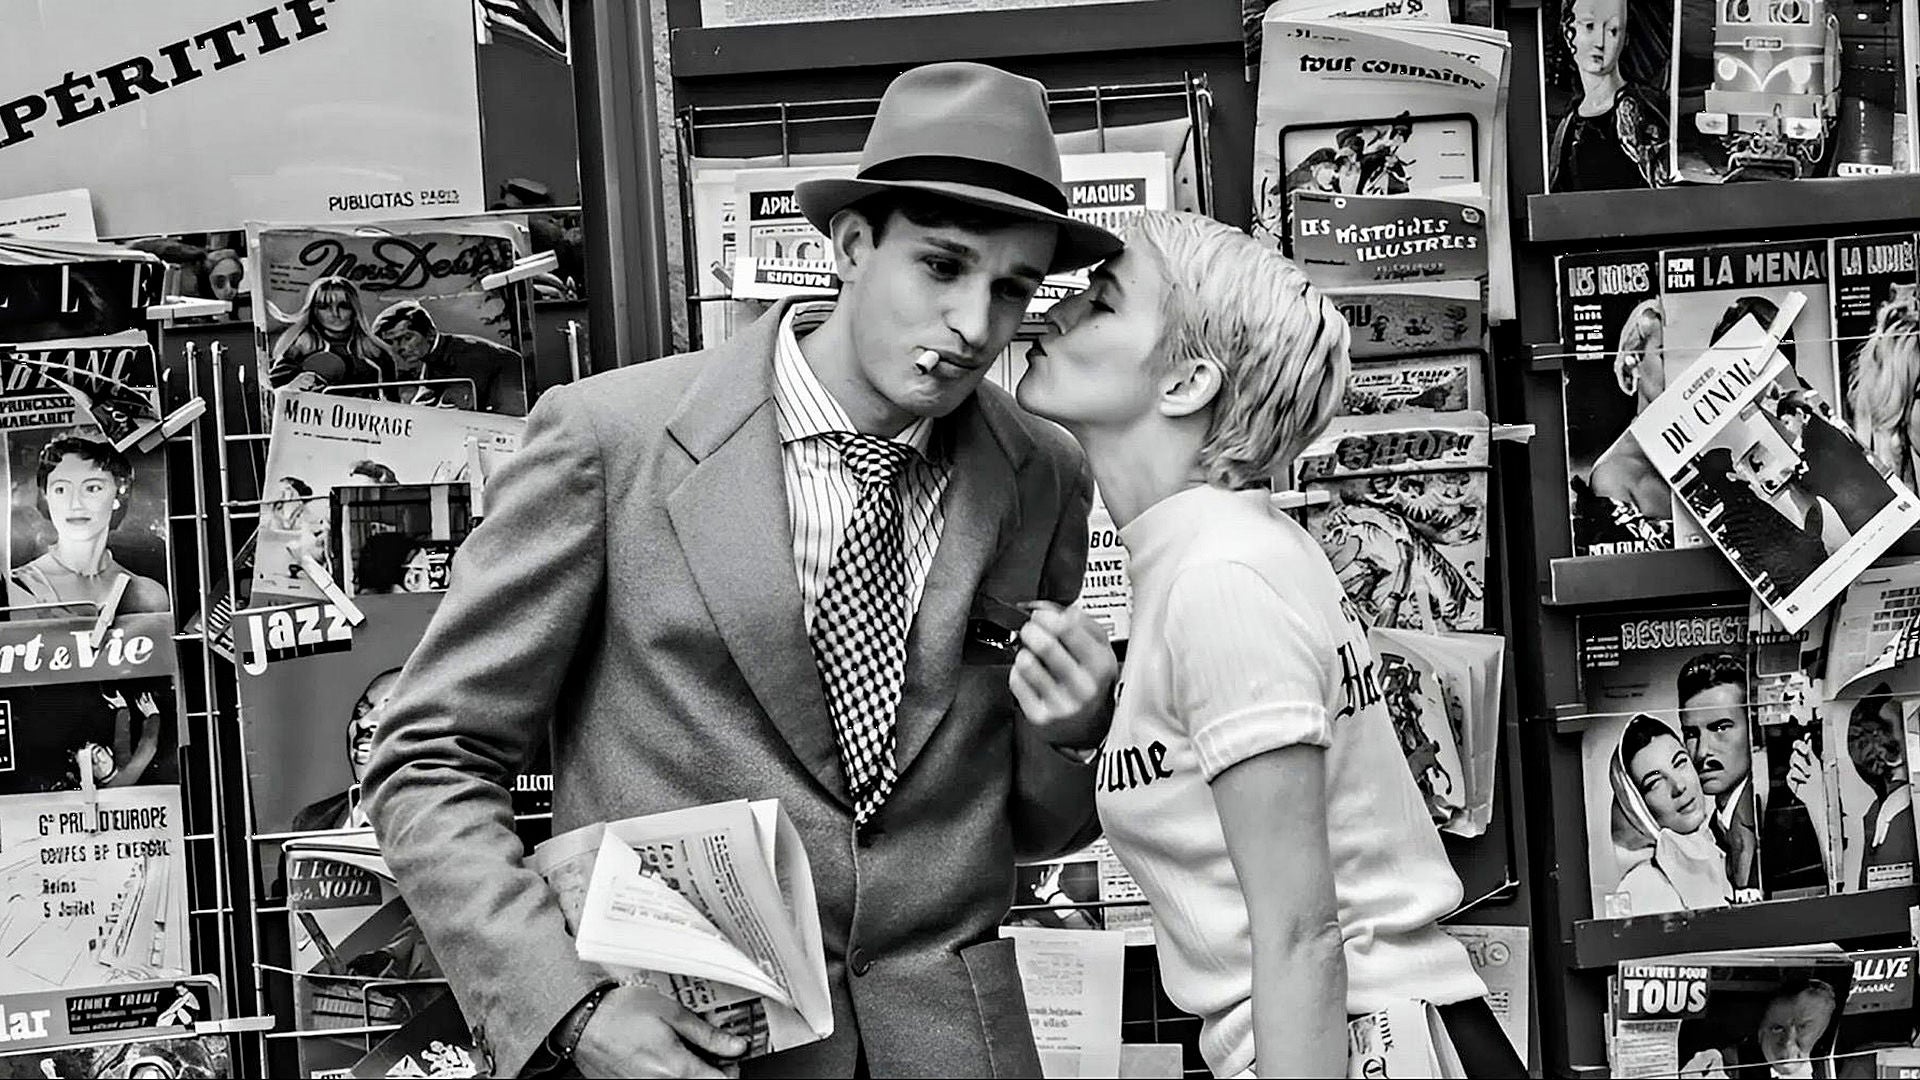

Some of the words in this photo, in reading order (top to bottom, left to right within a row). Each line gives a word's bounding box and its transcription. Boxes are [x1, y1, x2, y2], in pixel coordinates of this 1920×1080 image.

[1300, 54, 1356, 71] tout
[329, 192, 413, 211] PUBLICITAS
[1073, 184, 1135, 204] MAQUIS
[1703, 256, 1734, 286] LA
[1841, 247, 1862, 275] LA
[766, 271, 831, 287] MAQUIS
[49, 646, 72, 671] &
[70, 628, 153, 668] Vie
[1098, 741, 1173, 793] une
[1623, 979, 1707, 1014] TOUS
